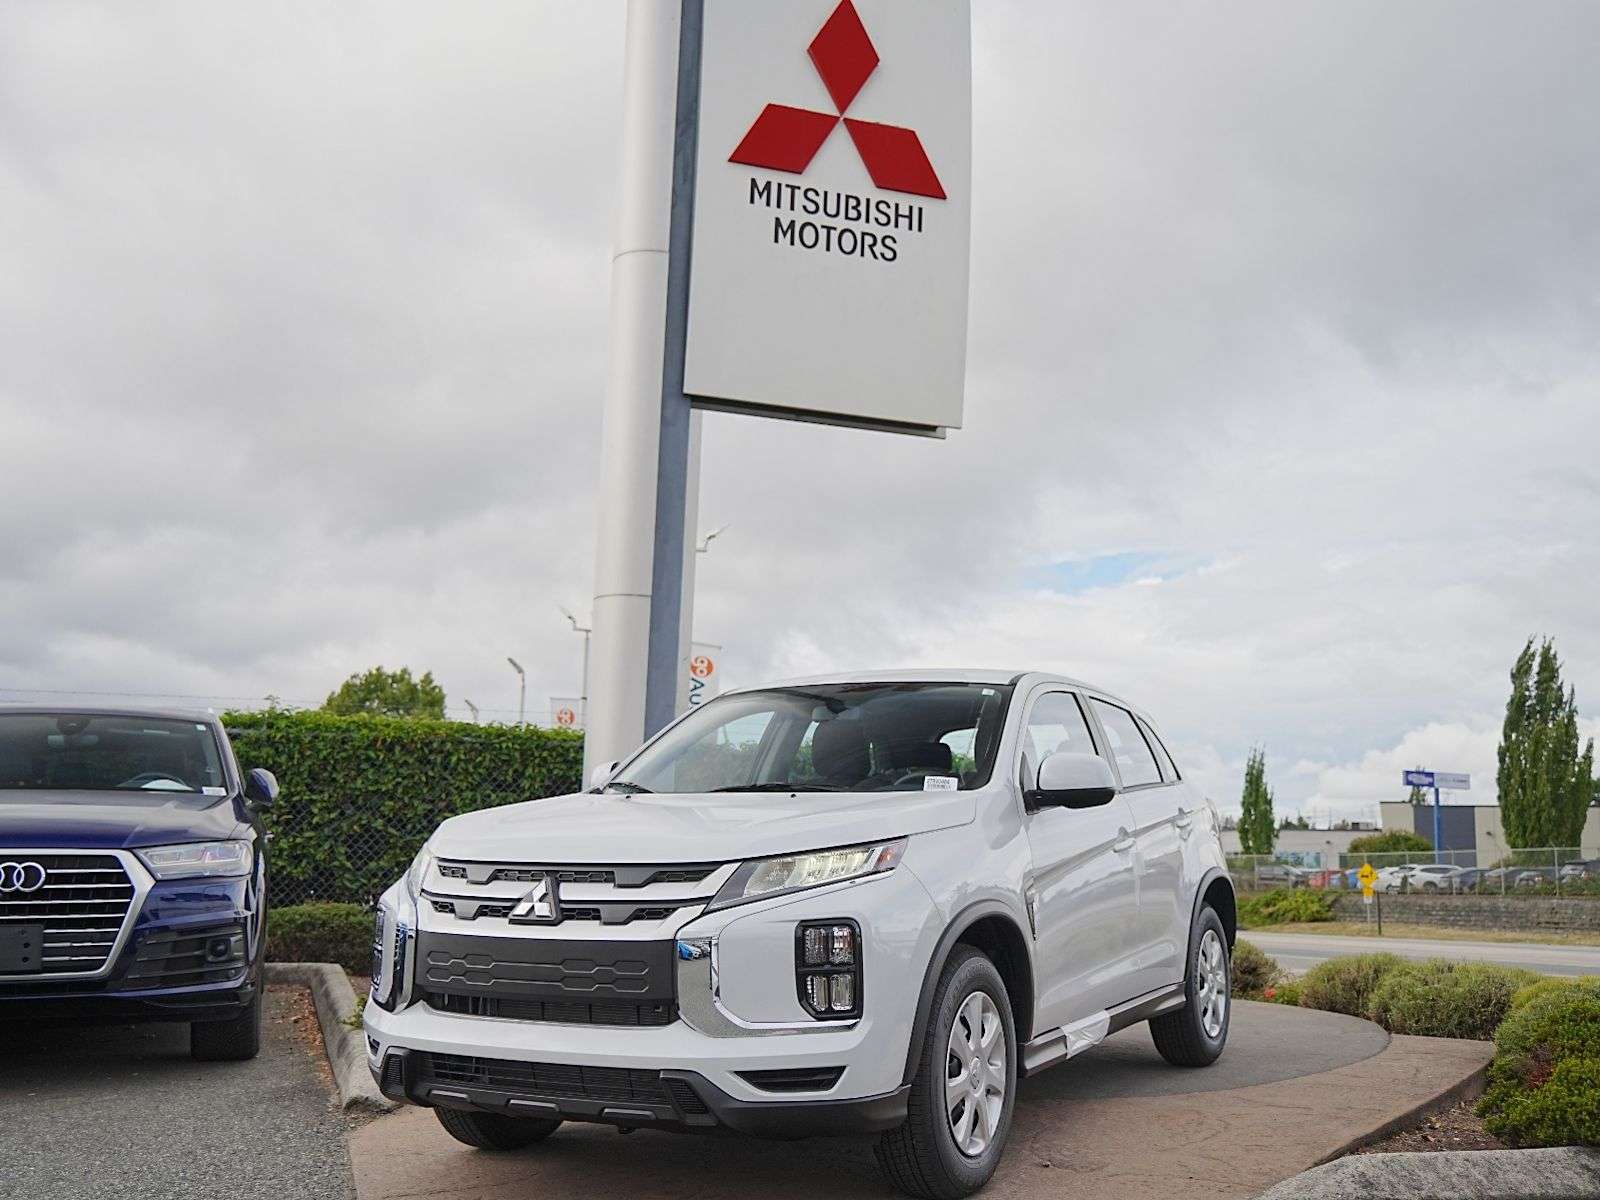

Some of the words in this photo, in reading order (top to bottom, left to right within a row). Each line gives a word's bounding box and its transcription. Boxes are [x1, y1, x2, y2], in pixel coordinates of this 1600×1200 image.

[750, 177, 923, 232] MITSUBISHI
[774, 217, 898, 262] MOTORS
[689, 678, 705, 706] AU
